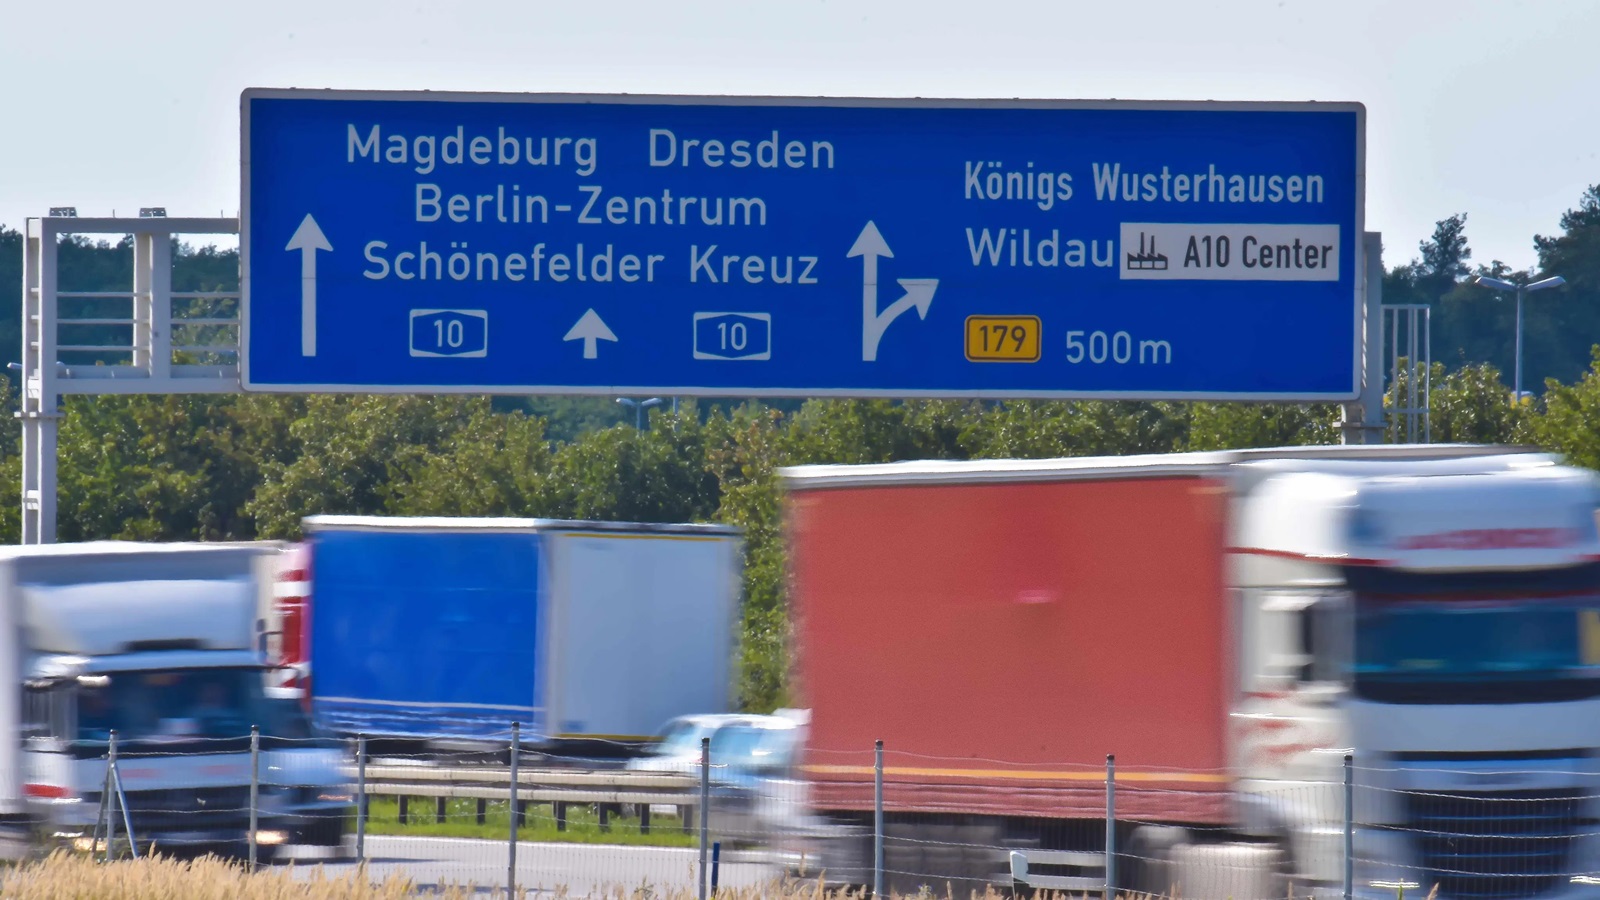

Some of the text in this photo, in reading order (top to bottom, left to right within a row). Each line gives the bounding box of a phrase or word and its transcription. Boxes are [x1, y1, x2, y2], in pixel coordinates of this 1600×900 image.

[347, 123, 835, 176] Magdeburg Dresden
[415, 182, 767, 227] Berlin-Zentrum
[964, 160, 1324, 211] Königs Wusterhausen
[363, 239, 819, 285] Schönefelder Kreuz
[965, 227, 1114, 268] Wildau
[1183, 234, 1334, 269] A10 Center
[433, 318, 464, 349] 10
[716, 321, 748, 352] 10
[978, 325, 1027, 354] 179
